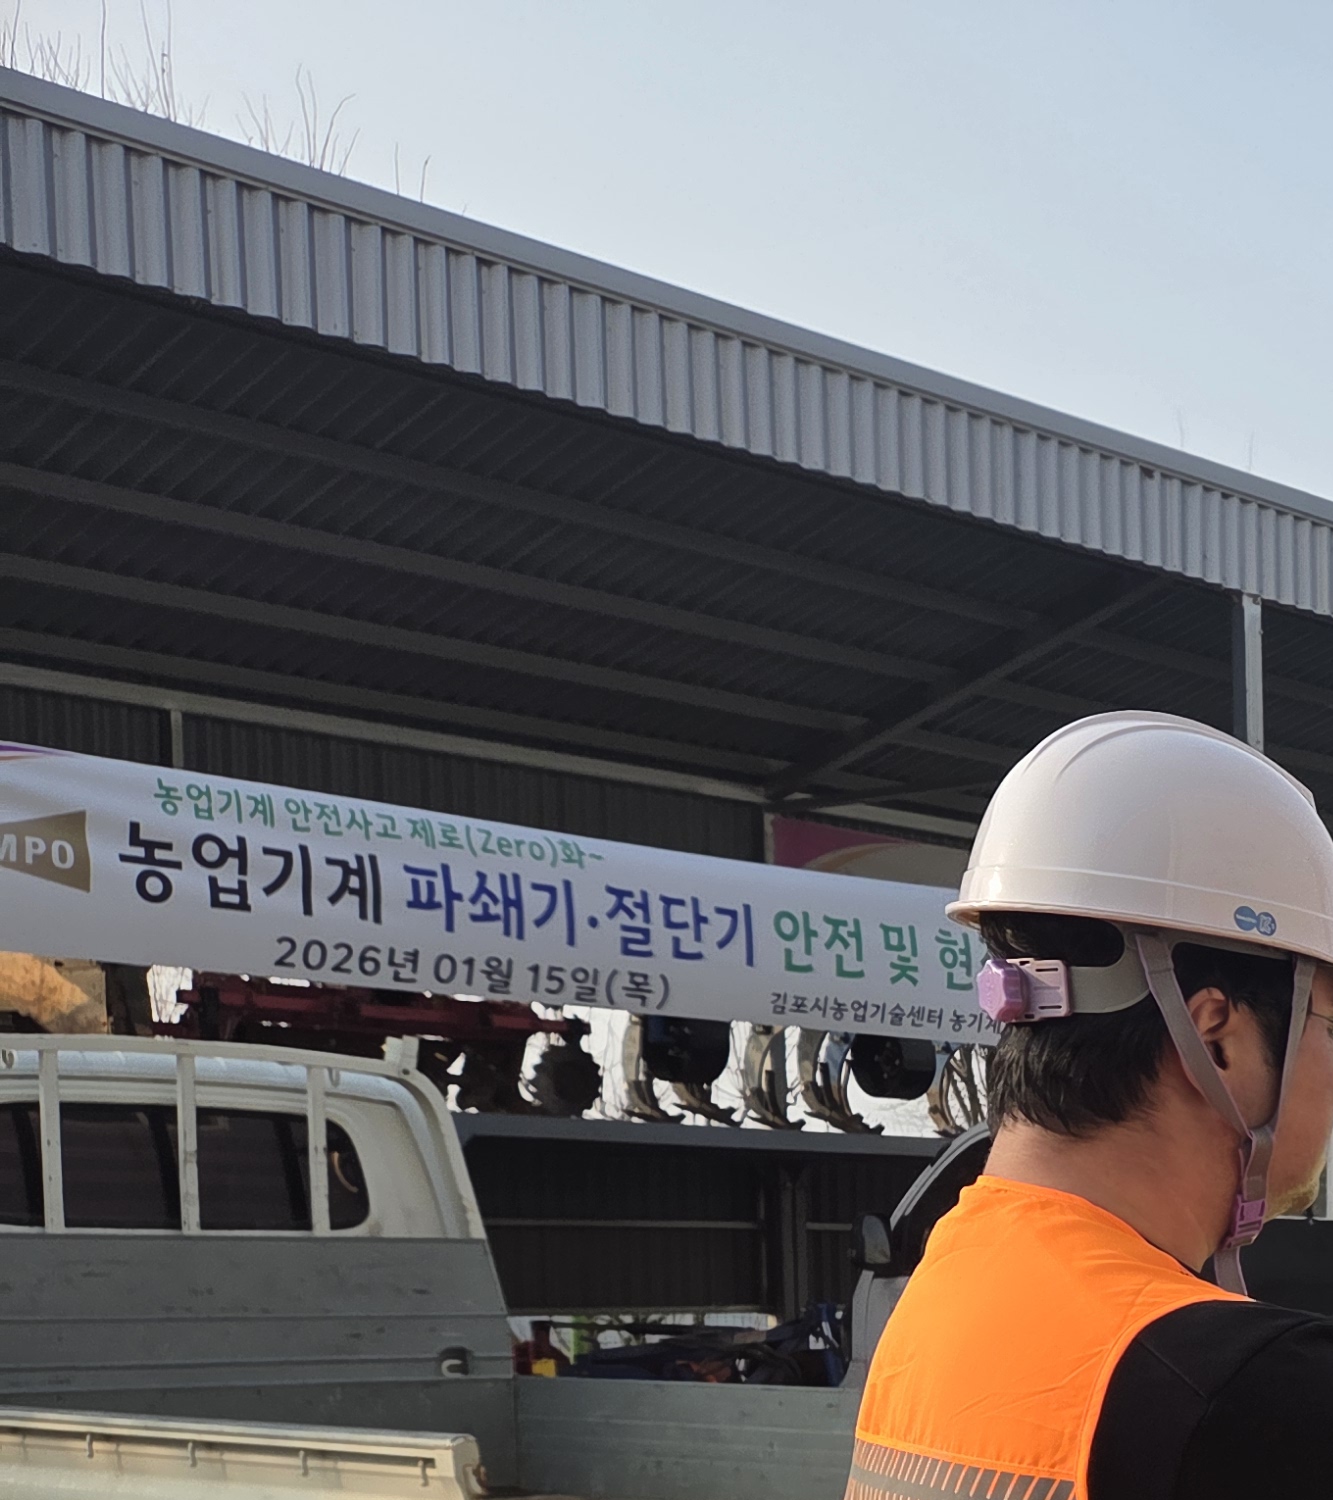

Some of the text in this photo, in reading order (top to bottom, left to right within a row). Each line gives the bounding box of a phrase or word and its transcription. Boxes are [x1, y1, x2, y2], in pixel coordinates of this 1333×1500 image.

[153, 778, 275, 829] 농업기계
[285, 797, 402, 841] 안전사고
[118, 820, 986, 991] 농업기계 파쇄기·절단기 안전 및 현
[273, 935, 671, 1010] 2026년 01월 15일(목)
[770, 991, 944, 1030] 김포시농업기술센터
